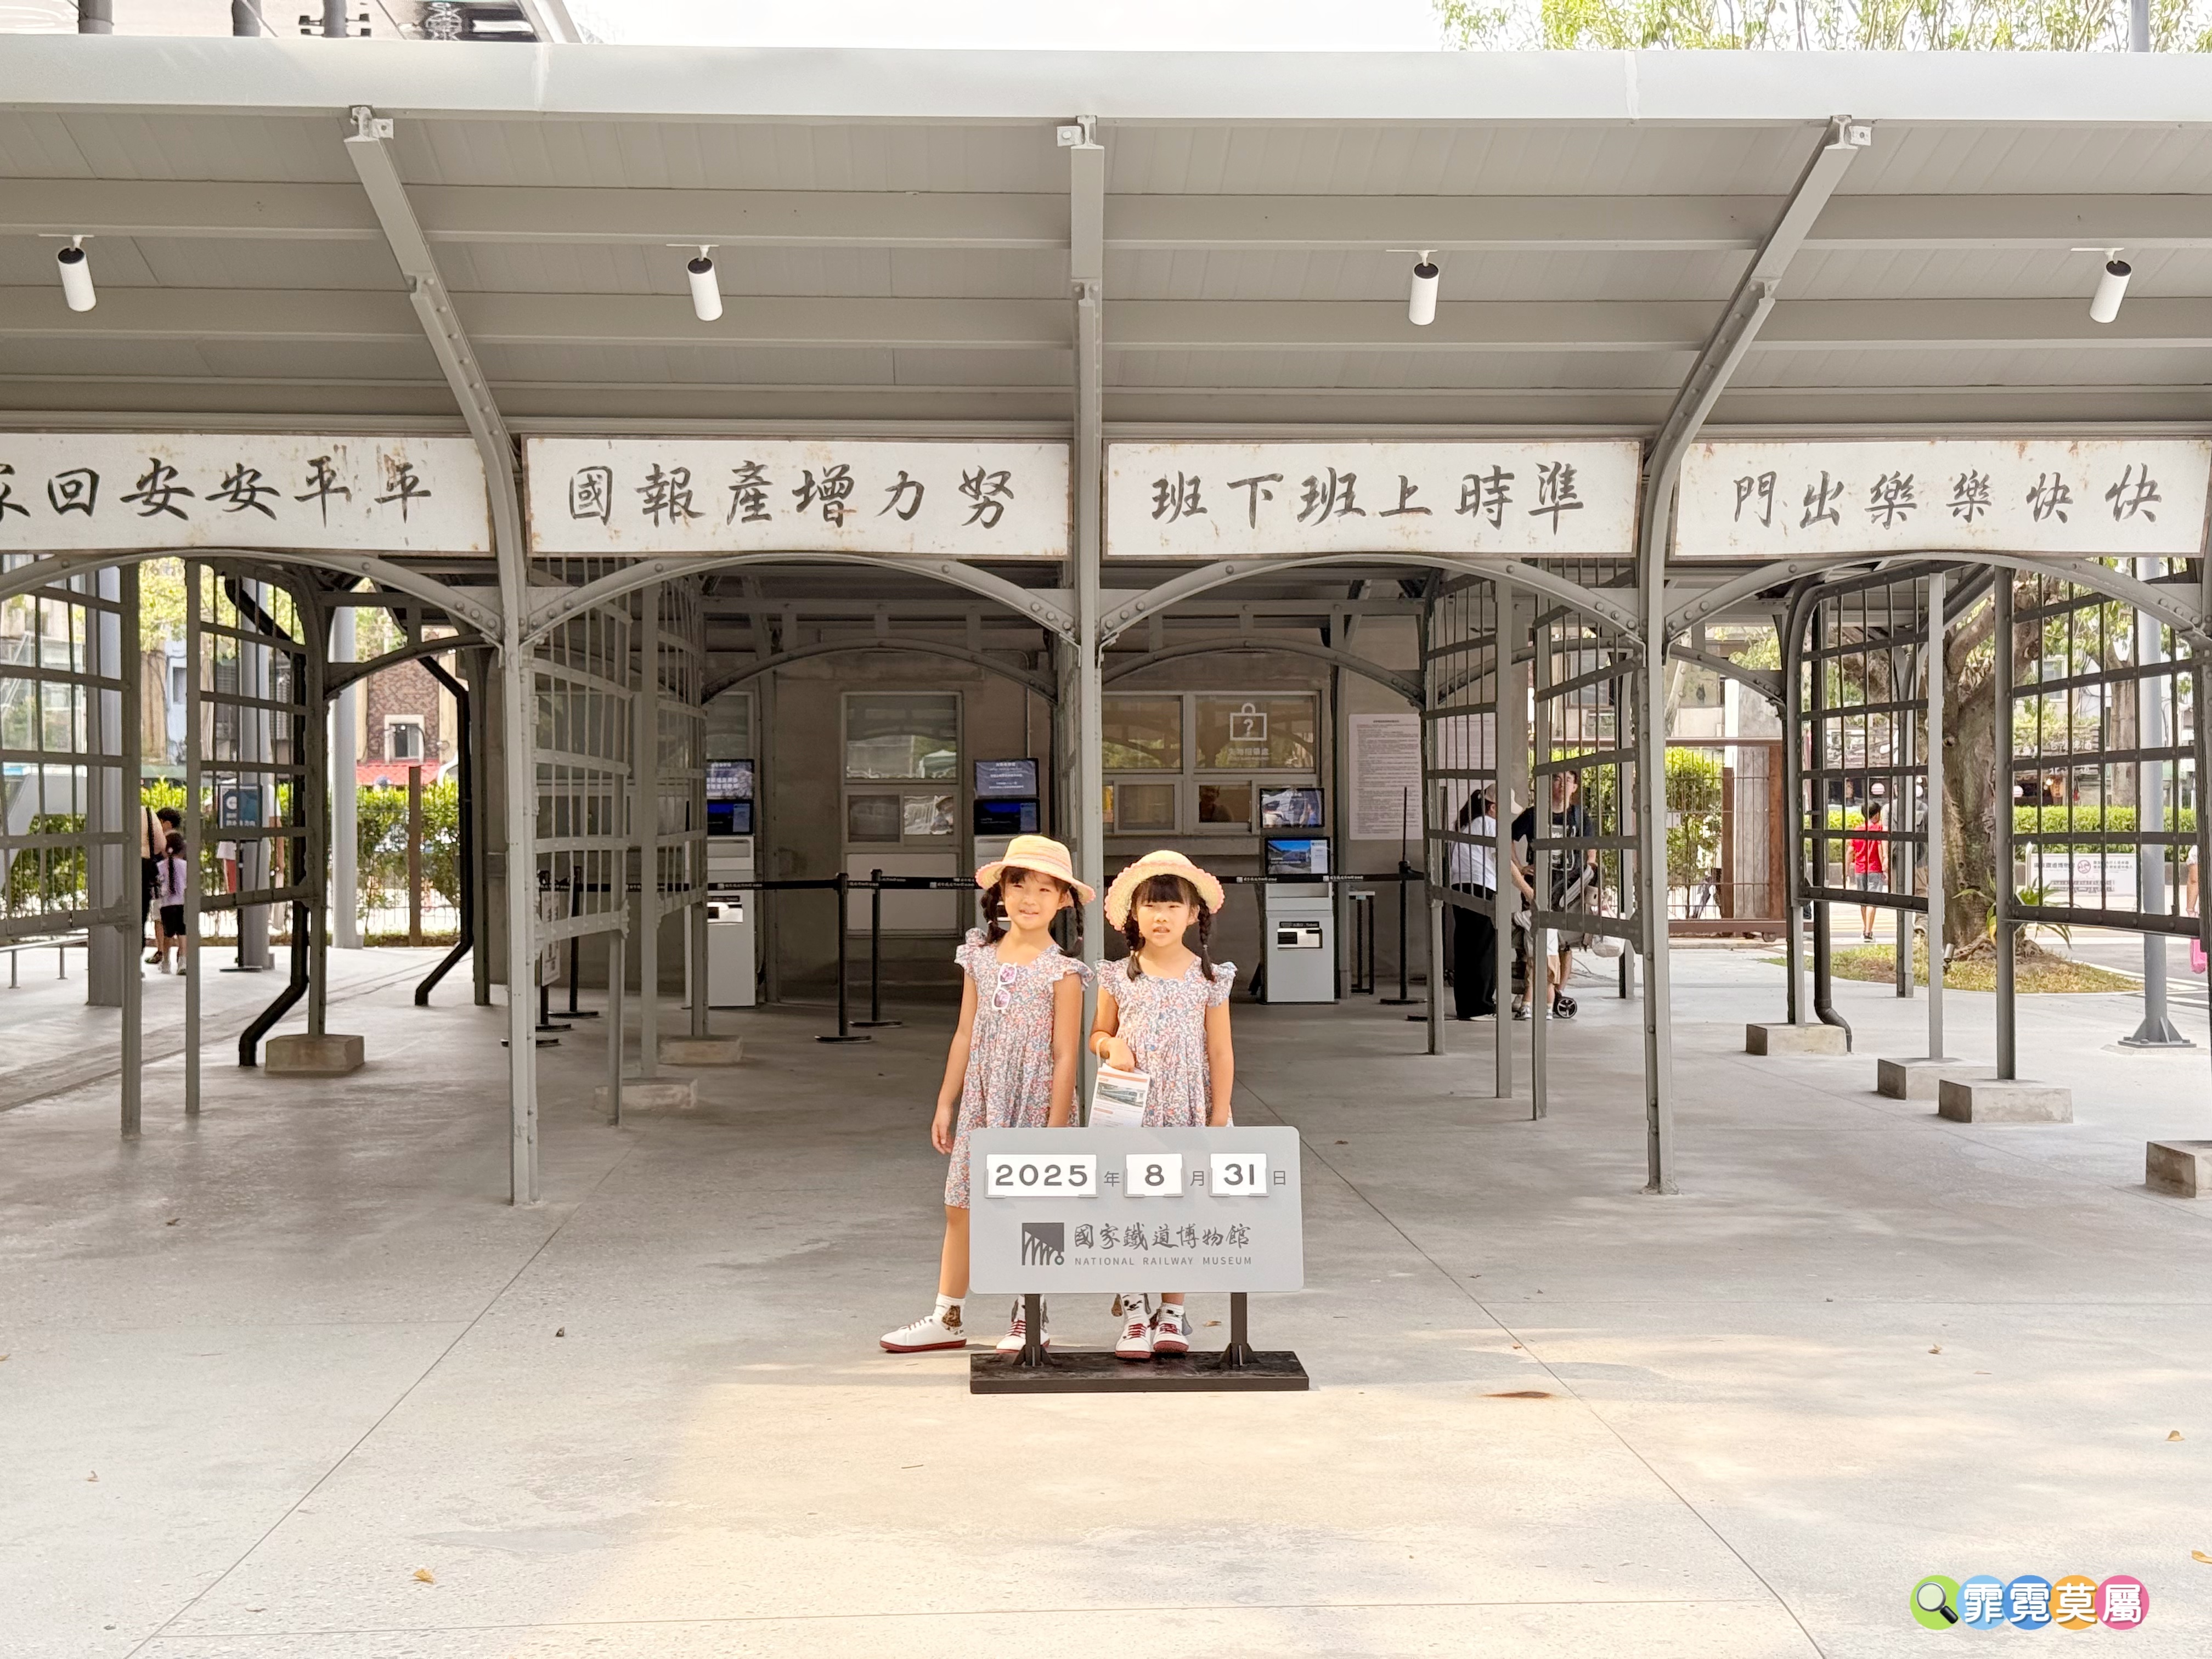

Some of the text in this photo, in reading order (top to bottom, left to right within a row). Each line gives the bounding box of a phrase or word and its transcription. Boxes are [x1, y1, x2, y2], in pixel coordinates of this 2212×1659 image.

[995, 1163, 1287, 1187] 2025 年 8 月 31 日
[1074, 1222, 1252, 1251] 國家鐵道博物館
[1074, 1256, 1252, 1266] NATIONAL RAILWAY MUSEUM
